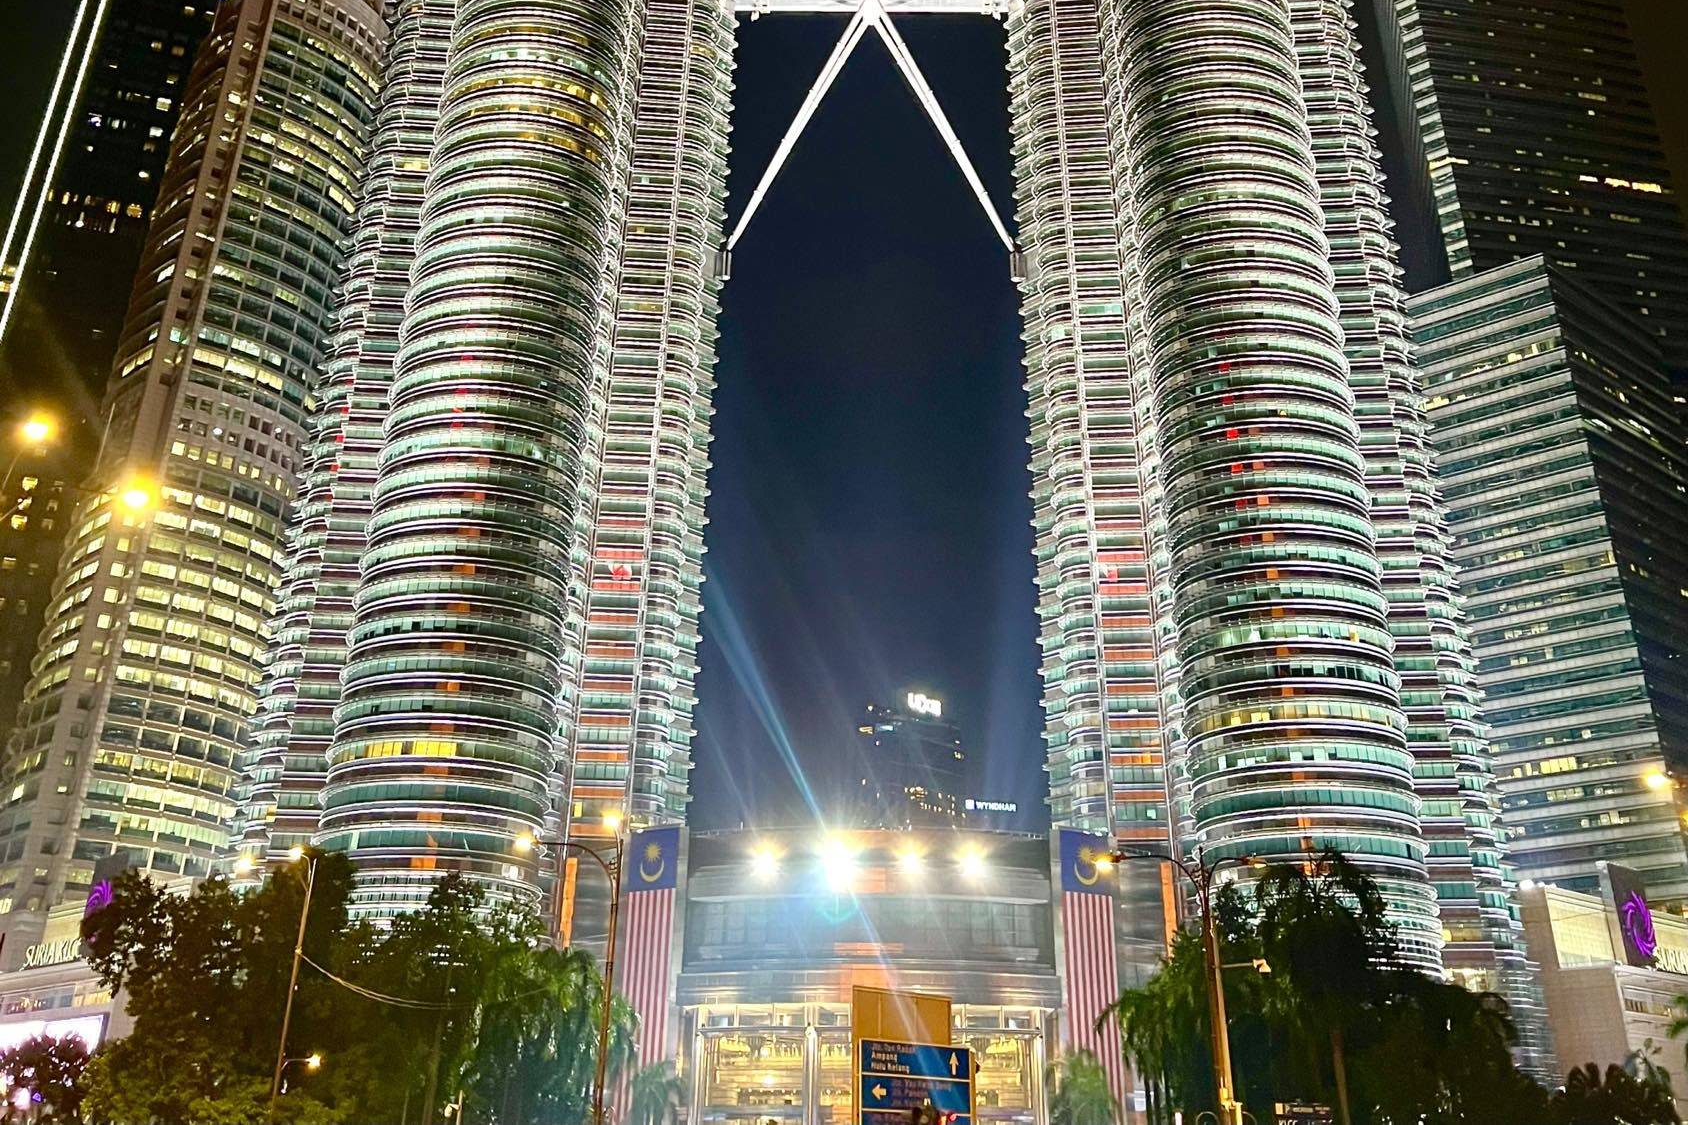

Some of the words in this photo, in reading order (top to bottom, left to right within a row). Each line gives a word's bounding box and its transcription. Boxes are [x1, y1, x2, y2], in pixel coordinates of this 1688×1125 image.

[976, 800, 1017, 813] WYNDHAM
[23, 944, 55, 967] SURIA
[871, 1050, 898, 1063] Ampang
